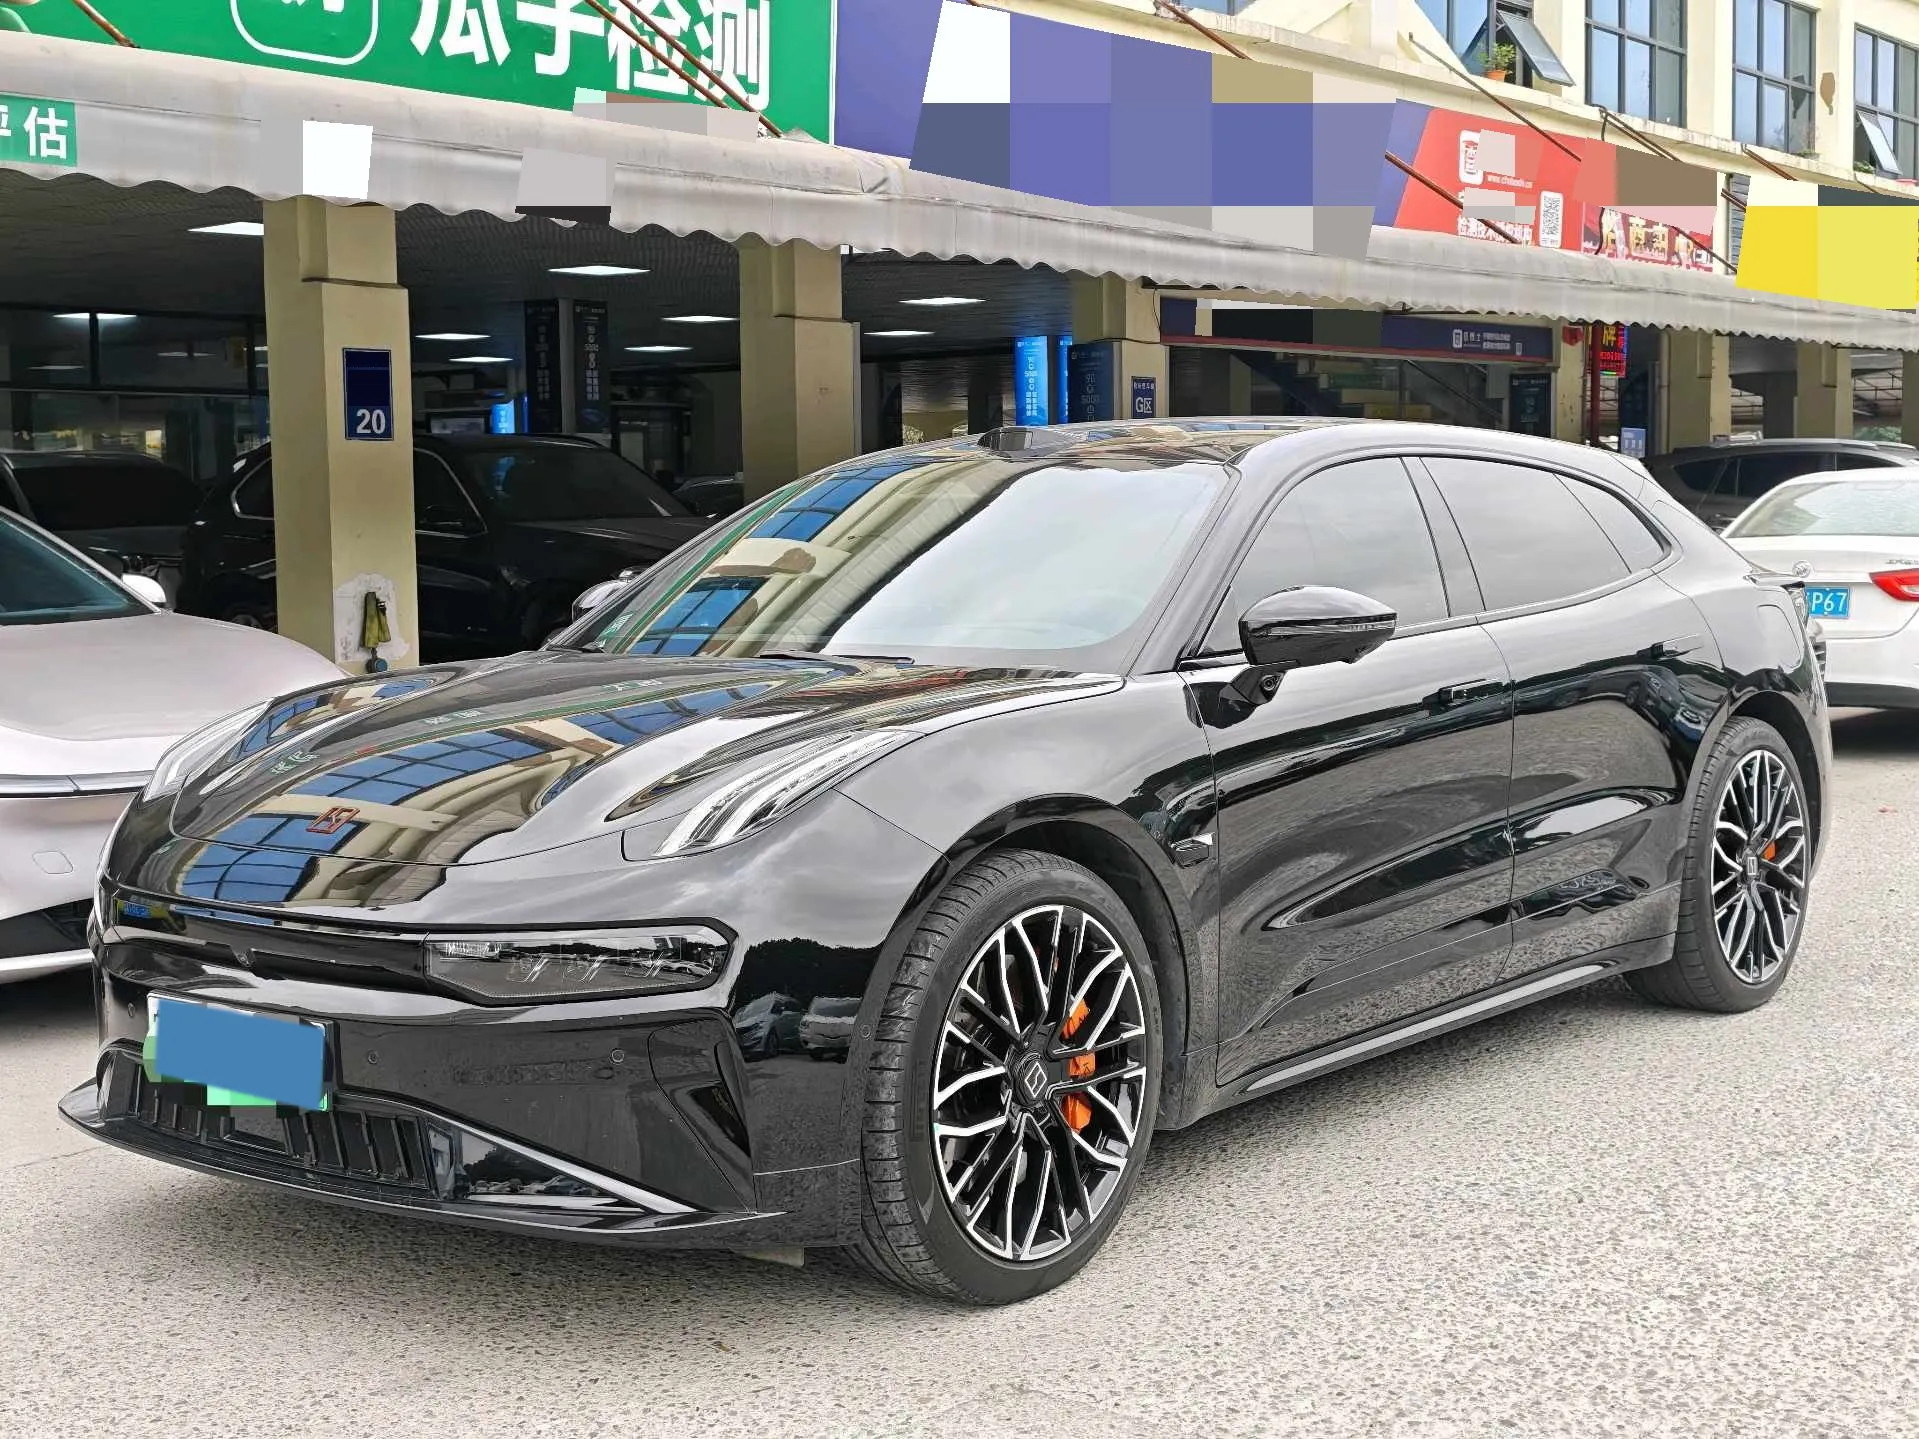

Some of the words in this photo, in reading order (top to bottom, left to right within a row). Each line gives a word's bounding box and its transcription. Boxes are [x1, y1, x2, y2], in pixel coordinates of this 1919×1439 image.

[411, 0, 770, 110] 瓜子检测
[356, 408, 386, 434] 20
[1807, 592, 1848, 613] P67
